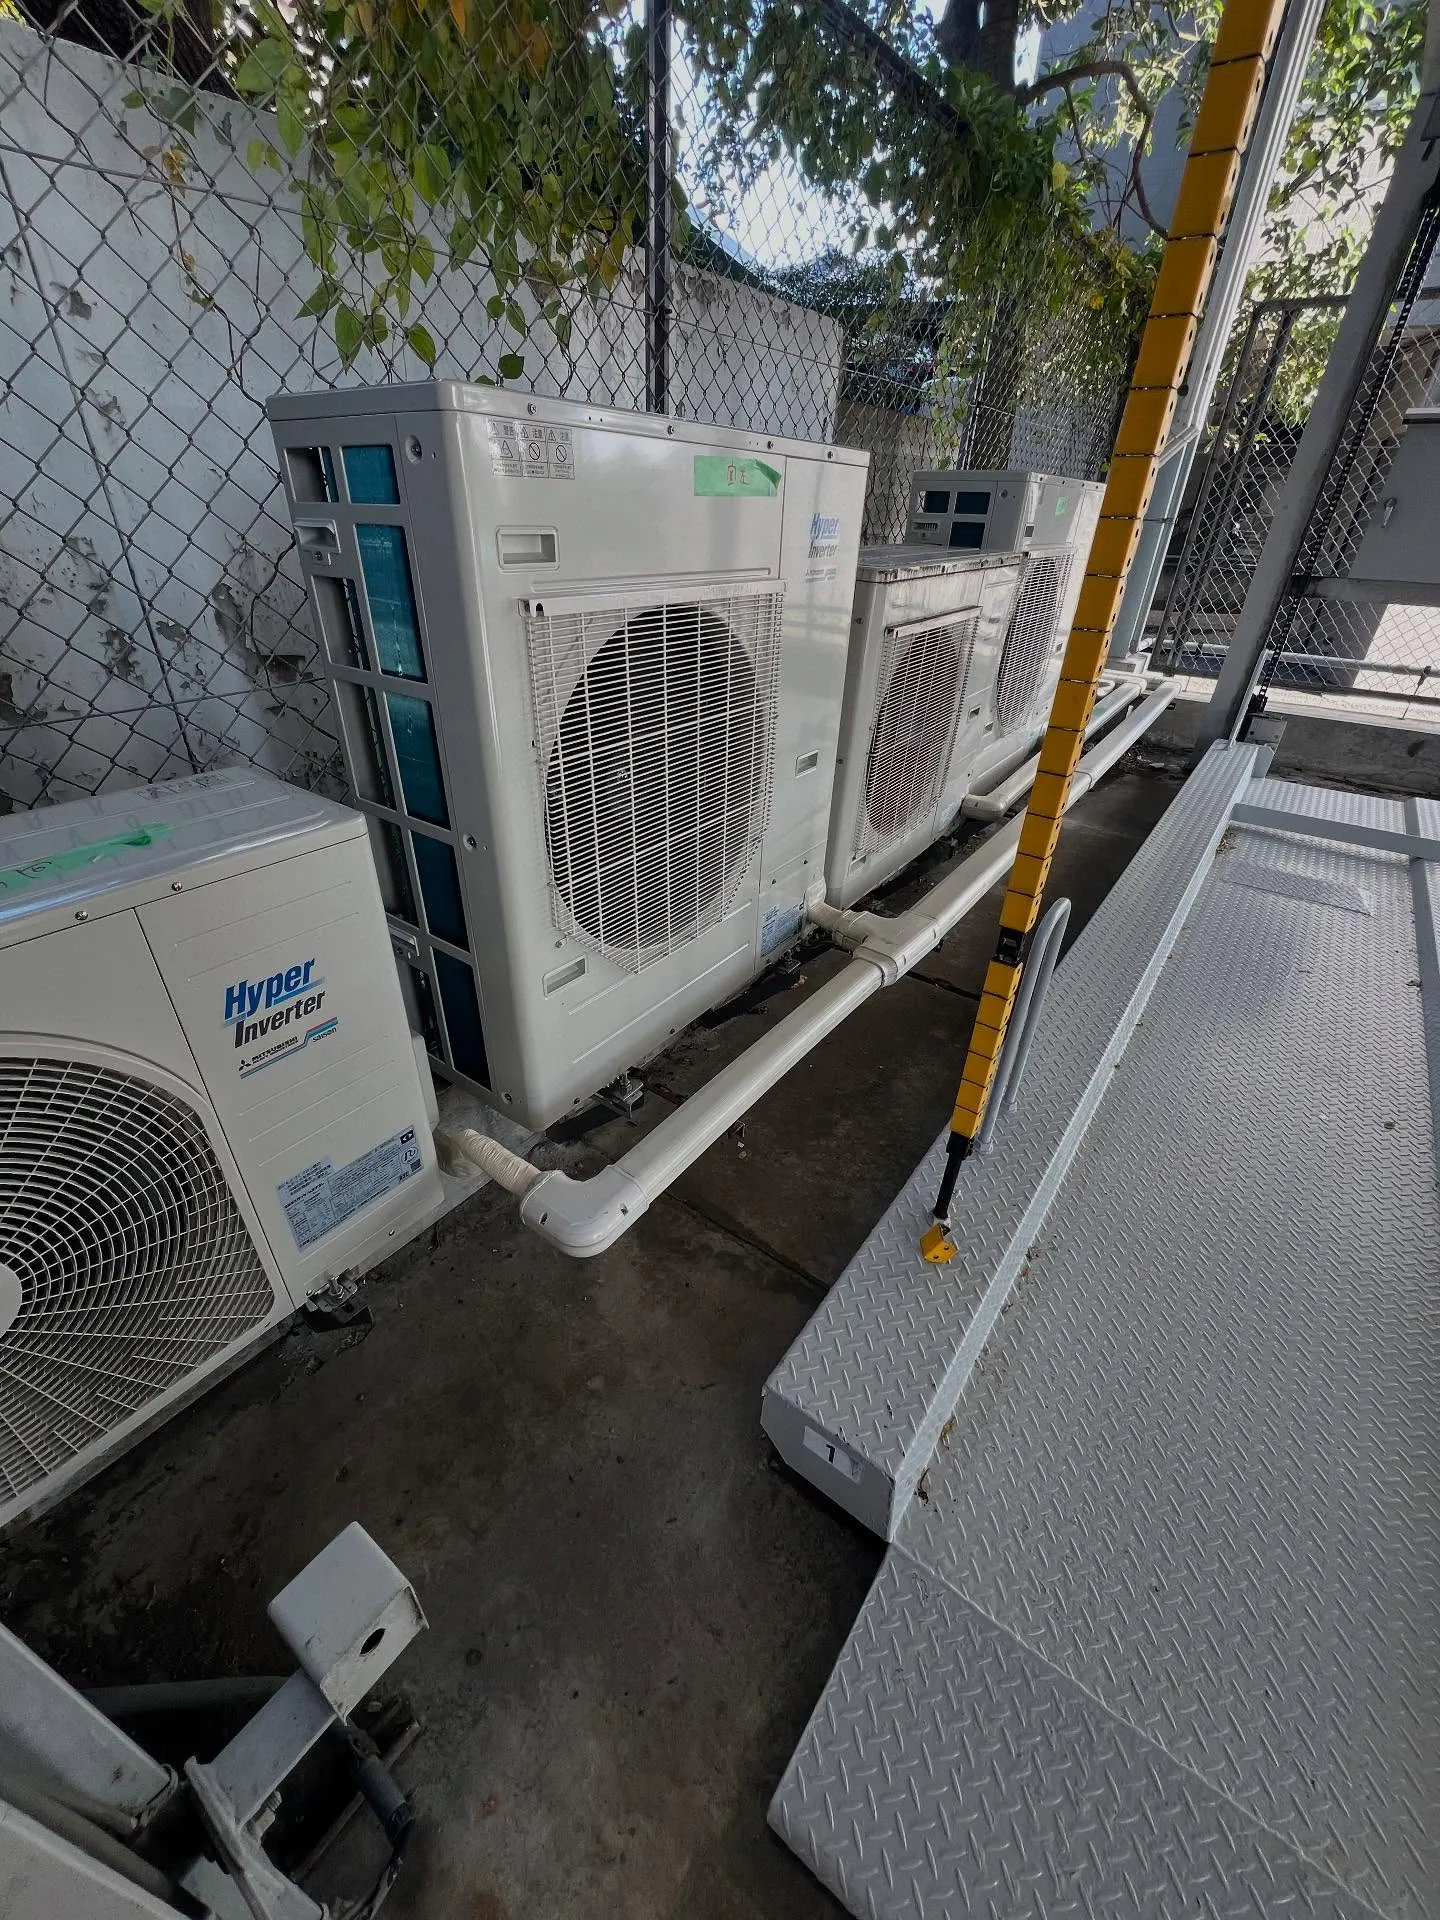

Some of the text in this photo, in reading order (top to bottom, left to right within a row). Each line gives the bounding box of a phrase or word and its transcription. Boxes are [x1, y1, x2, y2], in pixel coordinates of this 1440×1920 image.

[809, 512, 840, 541] Hyper
[808, 540, 839, 559] Inverter
[224, 957, 315, 1020] Hyper
[234, 990, 326, 1049] Inverter
